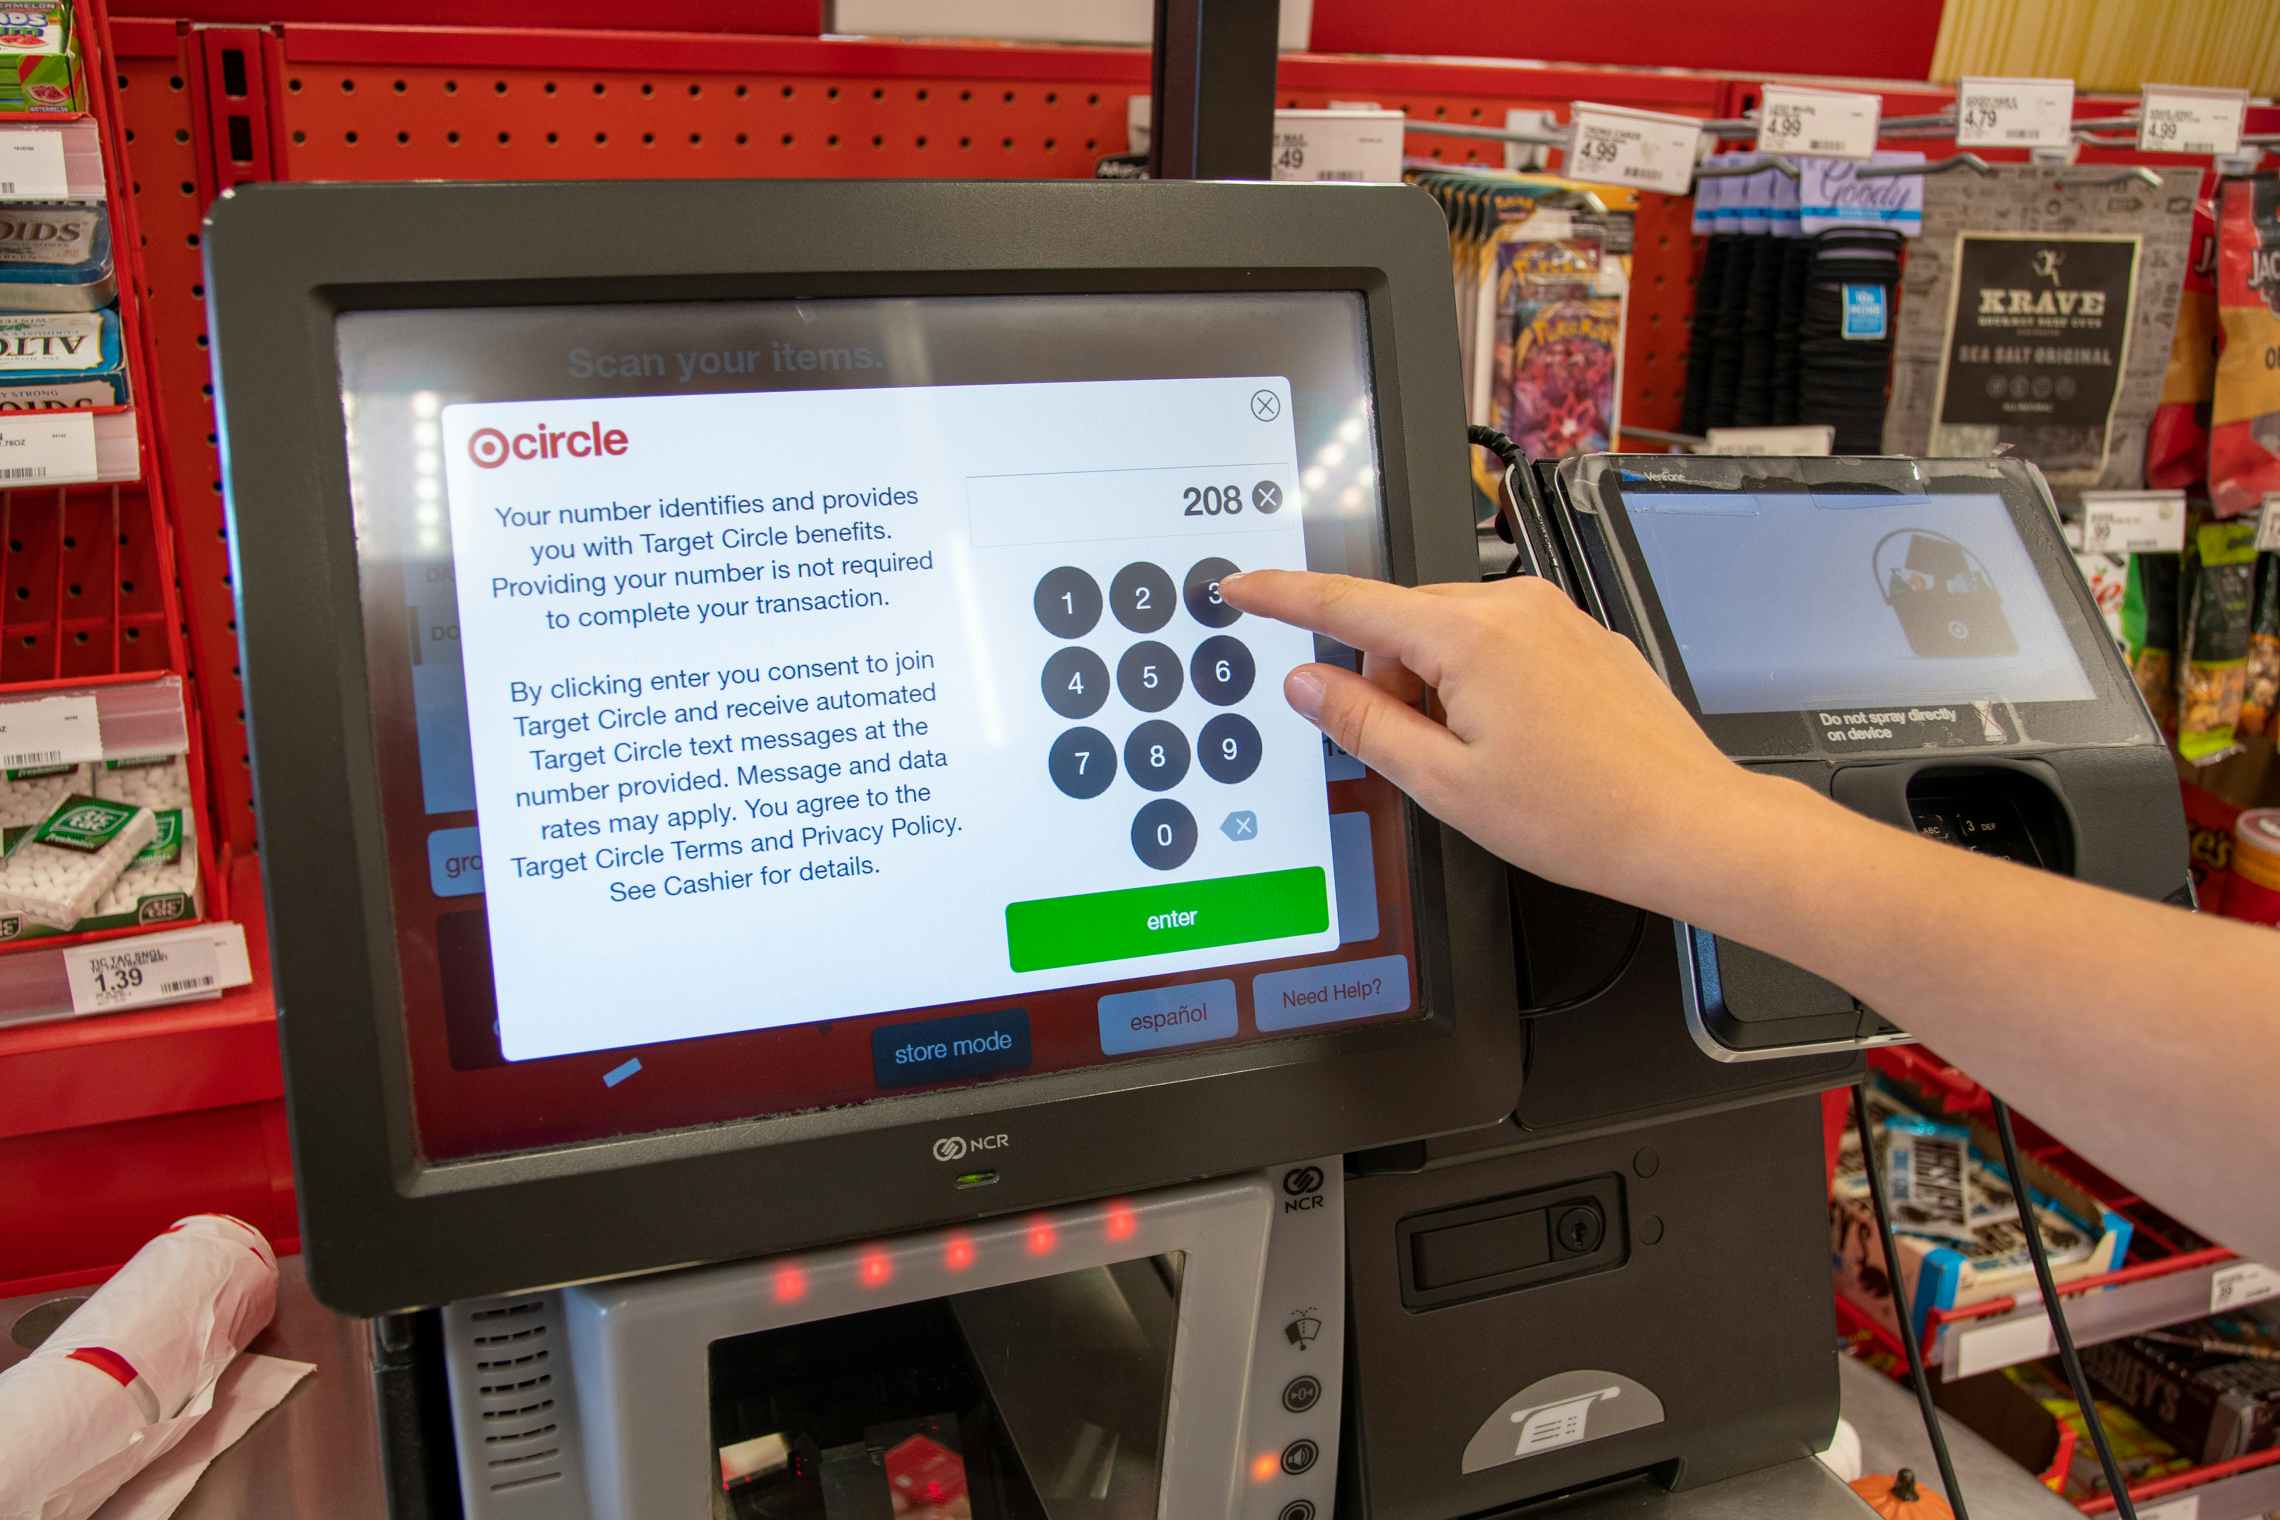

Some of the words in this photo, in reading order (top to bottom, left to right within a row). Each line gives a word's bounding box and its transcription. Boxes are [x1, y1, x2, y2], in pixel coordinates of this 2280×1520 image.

[1767, 118, 1801, 137] 4.99
[1581, 142, 1617, 162] 4.99
[1978, 289, 2107, 316] KRAVE
[567, 347, 665, 380] Scan
[676, 350, 761, 383] your
[772, 342, 884, 372] items.
[1994, 346, 2031, 363] SALT
[2034, 348, 2112, 366] ORIGINAL
[512, 421, 630, 461] circle
[495, 506, 552, 528] Your
[559, 500, 652, 525] number
[658, 494, 765, 519] identifies
[771, 490, 815, 513] and
[822, 486, 919, 515] provides
[1182, 484, 1243, 516] 208
[529, 543, 576, 567] you
[582, 535, 633, 558] with
[639, 530, 715, 557] Target
[721, 525, 789, 549] Circle
[794, 520, 892, 545] benefits.
[491, 572, 607, 599] Providing
[613, 571, 668, 596] your
[674, 562, 766, 587] number
[771, 559, 791, 580] is
[797, 557, 836, 579] not
[841, 549, 934, 579] required
[1061, 592, 1075, 615] 1
[1135, 587, 1152, 610] 2
[1207, 582, 1223, 604] 3
[545, 610, 571, 630] to
[578, 601, 691, 629] complete
[696, 600, 750, 625] your
[754, 590, 890, 615] transaction.
[510, 680, 543, 707] By
[550, 673, 643, 699] clicking
[650, 669, 711, 691] enter
[716, 667, 761, 691] you
[767, 655, 860, 682] consent
[865, 654, 889, 674] to
[895, 649, 935, 677] join
[1067, 672, 1085, 695] 4
[1142, 666, 1158, 688] 5
[1215, 660, 1232, 682] 6
[512, 711, 591, 740] Target
[597, 705, 667, 730] Circle
[674, 699, 719, 724] and
[726, 694, 809, 720] receive
[816, 681, 937, 711] automated
[1819, 712, 1842, 726] Do
[1844, 711, 1869, 725] not
[1869, 711, 1906, 726] spray
[1908, 707, 1957, 723] directly
[528, 745, 607, 773] Target
[613, 738, 683, 763] Circle
[688, 733, 734, 757] text
[740, 727, 858, 752] messages
[864, 720, 887, 741] at
[891, 717, 929, 738] the
[1827, 729, 1846, 742] on
[1848, 726, 1893, 740] device
[1149, 745, 1166, 767] 8
[1222, 738, 1239, 760] 9
[1074, 752, 1091, 775] 7
[515, 781, 611, 808] number
[617, 767, 729, 797] provided.
[736, 762, 842, 787] Message
[848, 752, 891, 776] and
[898, 749, 949, 771] data
[541, 818, 601, 841] rates
[608, 813, 660, 836] may
[667, 802, 737, 832] apply.
[743, 798, 789, 819] You
[796, 793, 860, 818] agree
[865, 788, 889, 808] to
[894, 783, 931, 805] the
[509, 851, 589, 880] Target
[595, 843, 665, 869] Circle
[669, 839, 744, 862] Terms
[751, 828, 794, 853] and
[801, 824, 884, 848] Privacy
[891, 814, 963, 839] Policy.
[1156, 823, 1173, 847] 0
[609, 881, 657, 903] See
[663, 869, 754, 897] Cashier
[759, 865, 792, 888] for
[799, 855, 880, 882] details.
[1146, 908, 1198, 932] enter
[95, 967, 143, 993] 1.39
[1282, 988, 1323, 1010] Need
[1327, 977, 1383, 1006] Help?
[1129, 1002, 1209, 1032] español
[894, 1042, 948, 1066] store
[953, 1029, 1013, 1057] mode
[970, 1134, 1009, 1154] NCR
[1285, 1195, 1324, 1214] NCR
